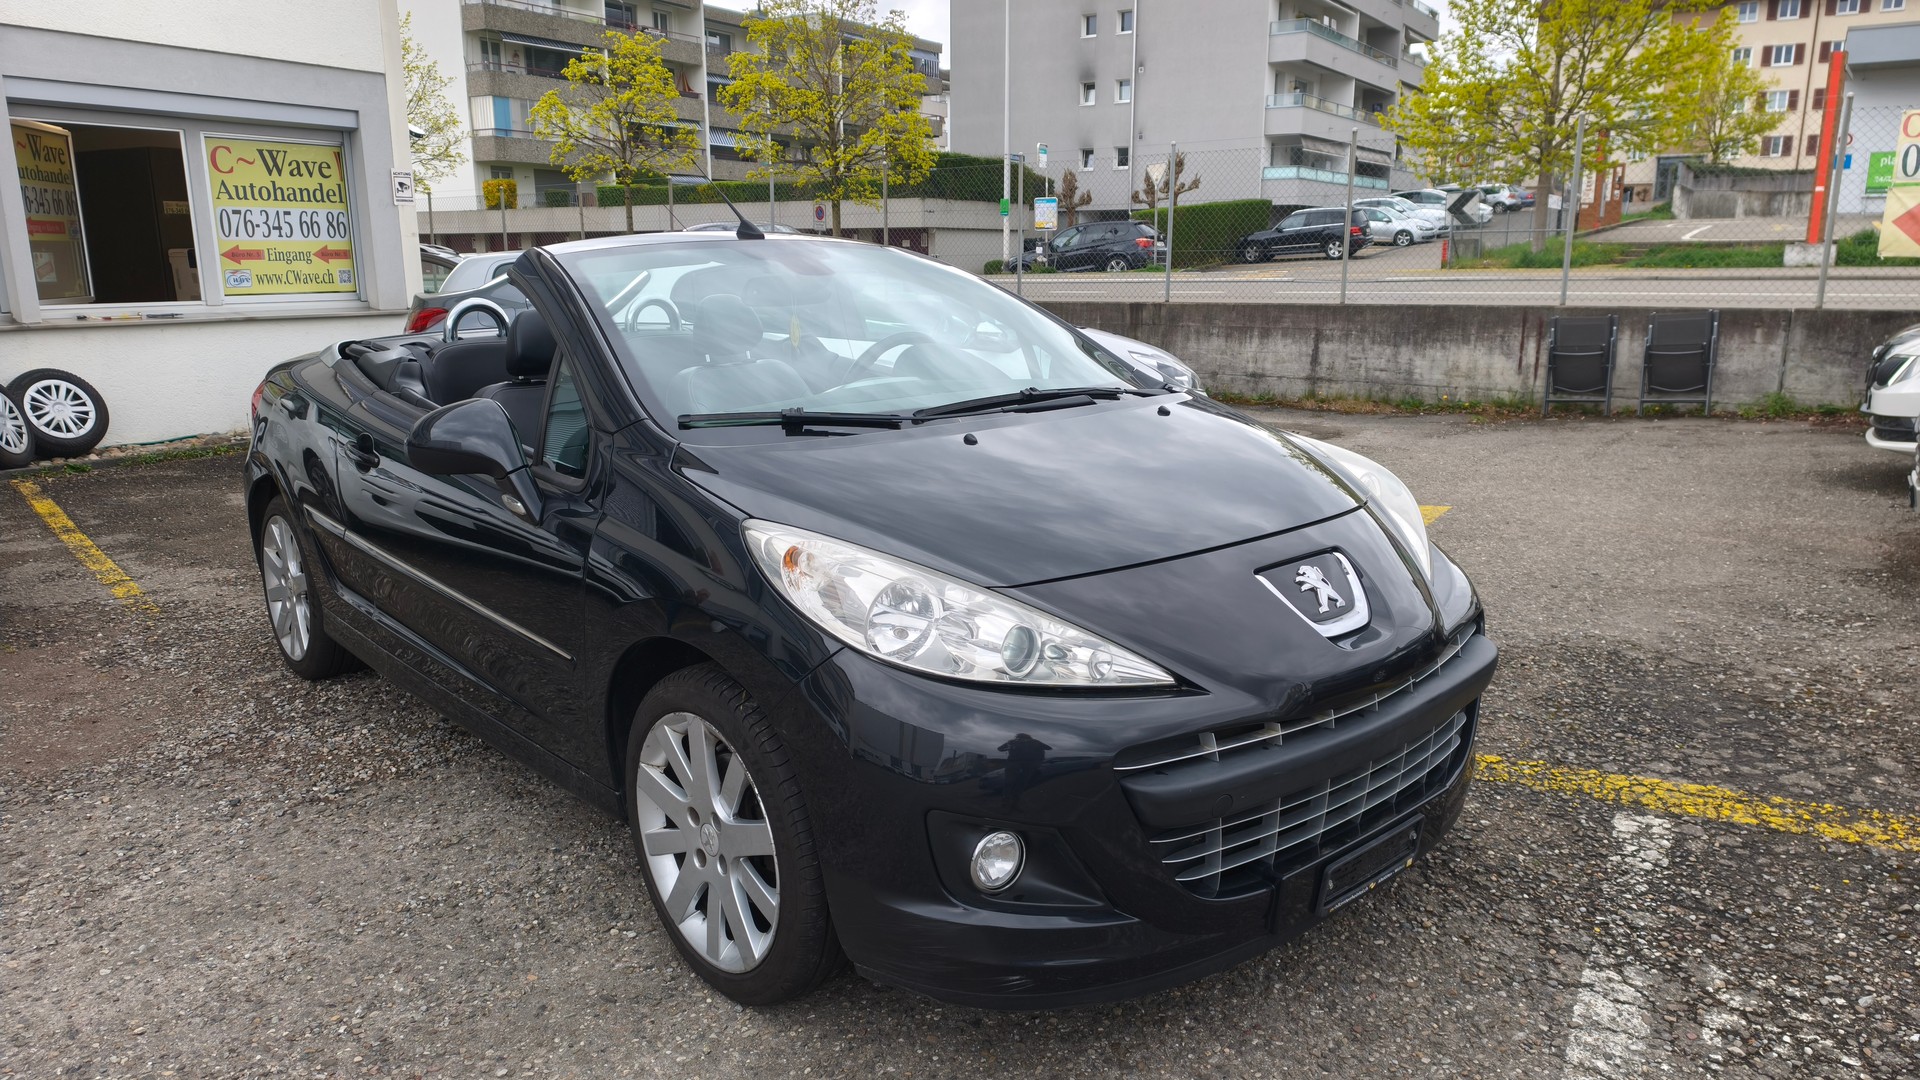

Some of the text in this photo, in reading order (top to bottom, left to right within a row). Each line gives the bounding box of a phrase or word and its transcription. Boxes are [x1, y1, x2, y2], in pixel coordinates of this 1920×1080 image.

[17, 134, 65, 165] ~Wave
[17, 165, 73, 184] utohande
[52, 189, 65, 216] 66
[216, 179, 345, 204] Autohandel
[219, 208, 347, 239] 076-345 66 86
[266, 248, 313, 265] Eingang
[256, 269, 335, 286] www.CWave.ch
